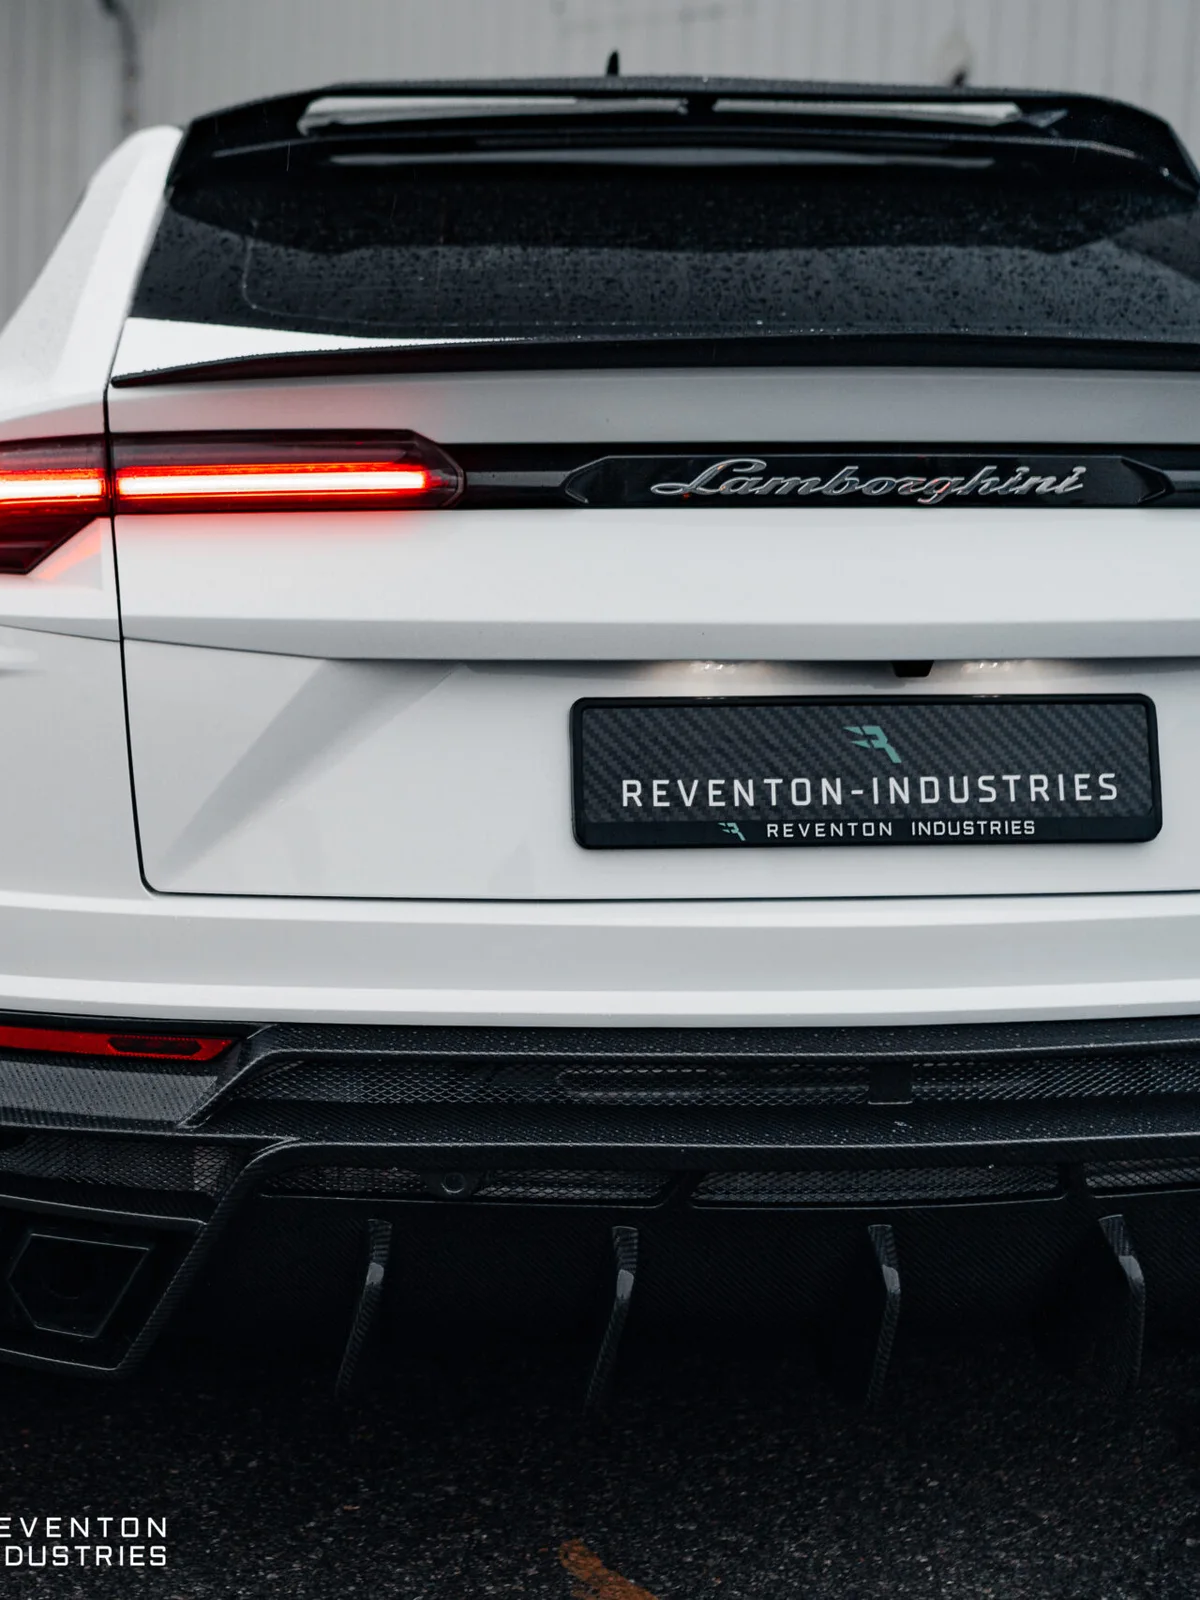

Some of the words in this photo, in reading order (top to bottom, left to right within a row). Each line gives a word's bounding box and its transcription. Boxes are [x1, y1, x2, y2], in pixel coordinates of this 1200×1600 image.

[650, 457, 1087, 504] Lamborghini
[621, 772, 1119, 808] REVENTON-INDUSTRIES
[766, 821, 893, 838] REVENTON
[911, 819, 1036, 836] INDUSTRIES
